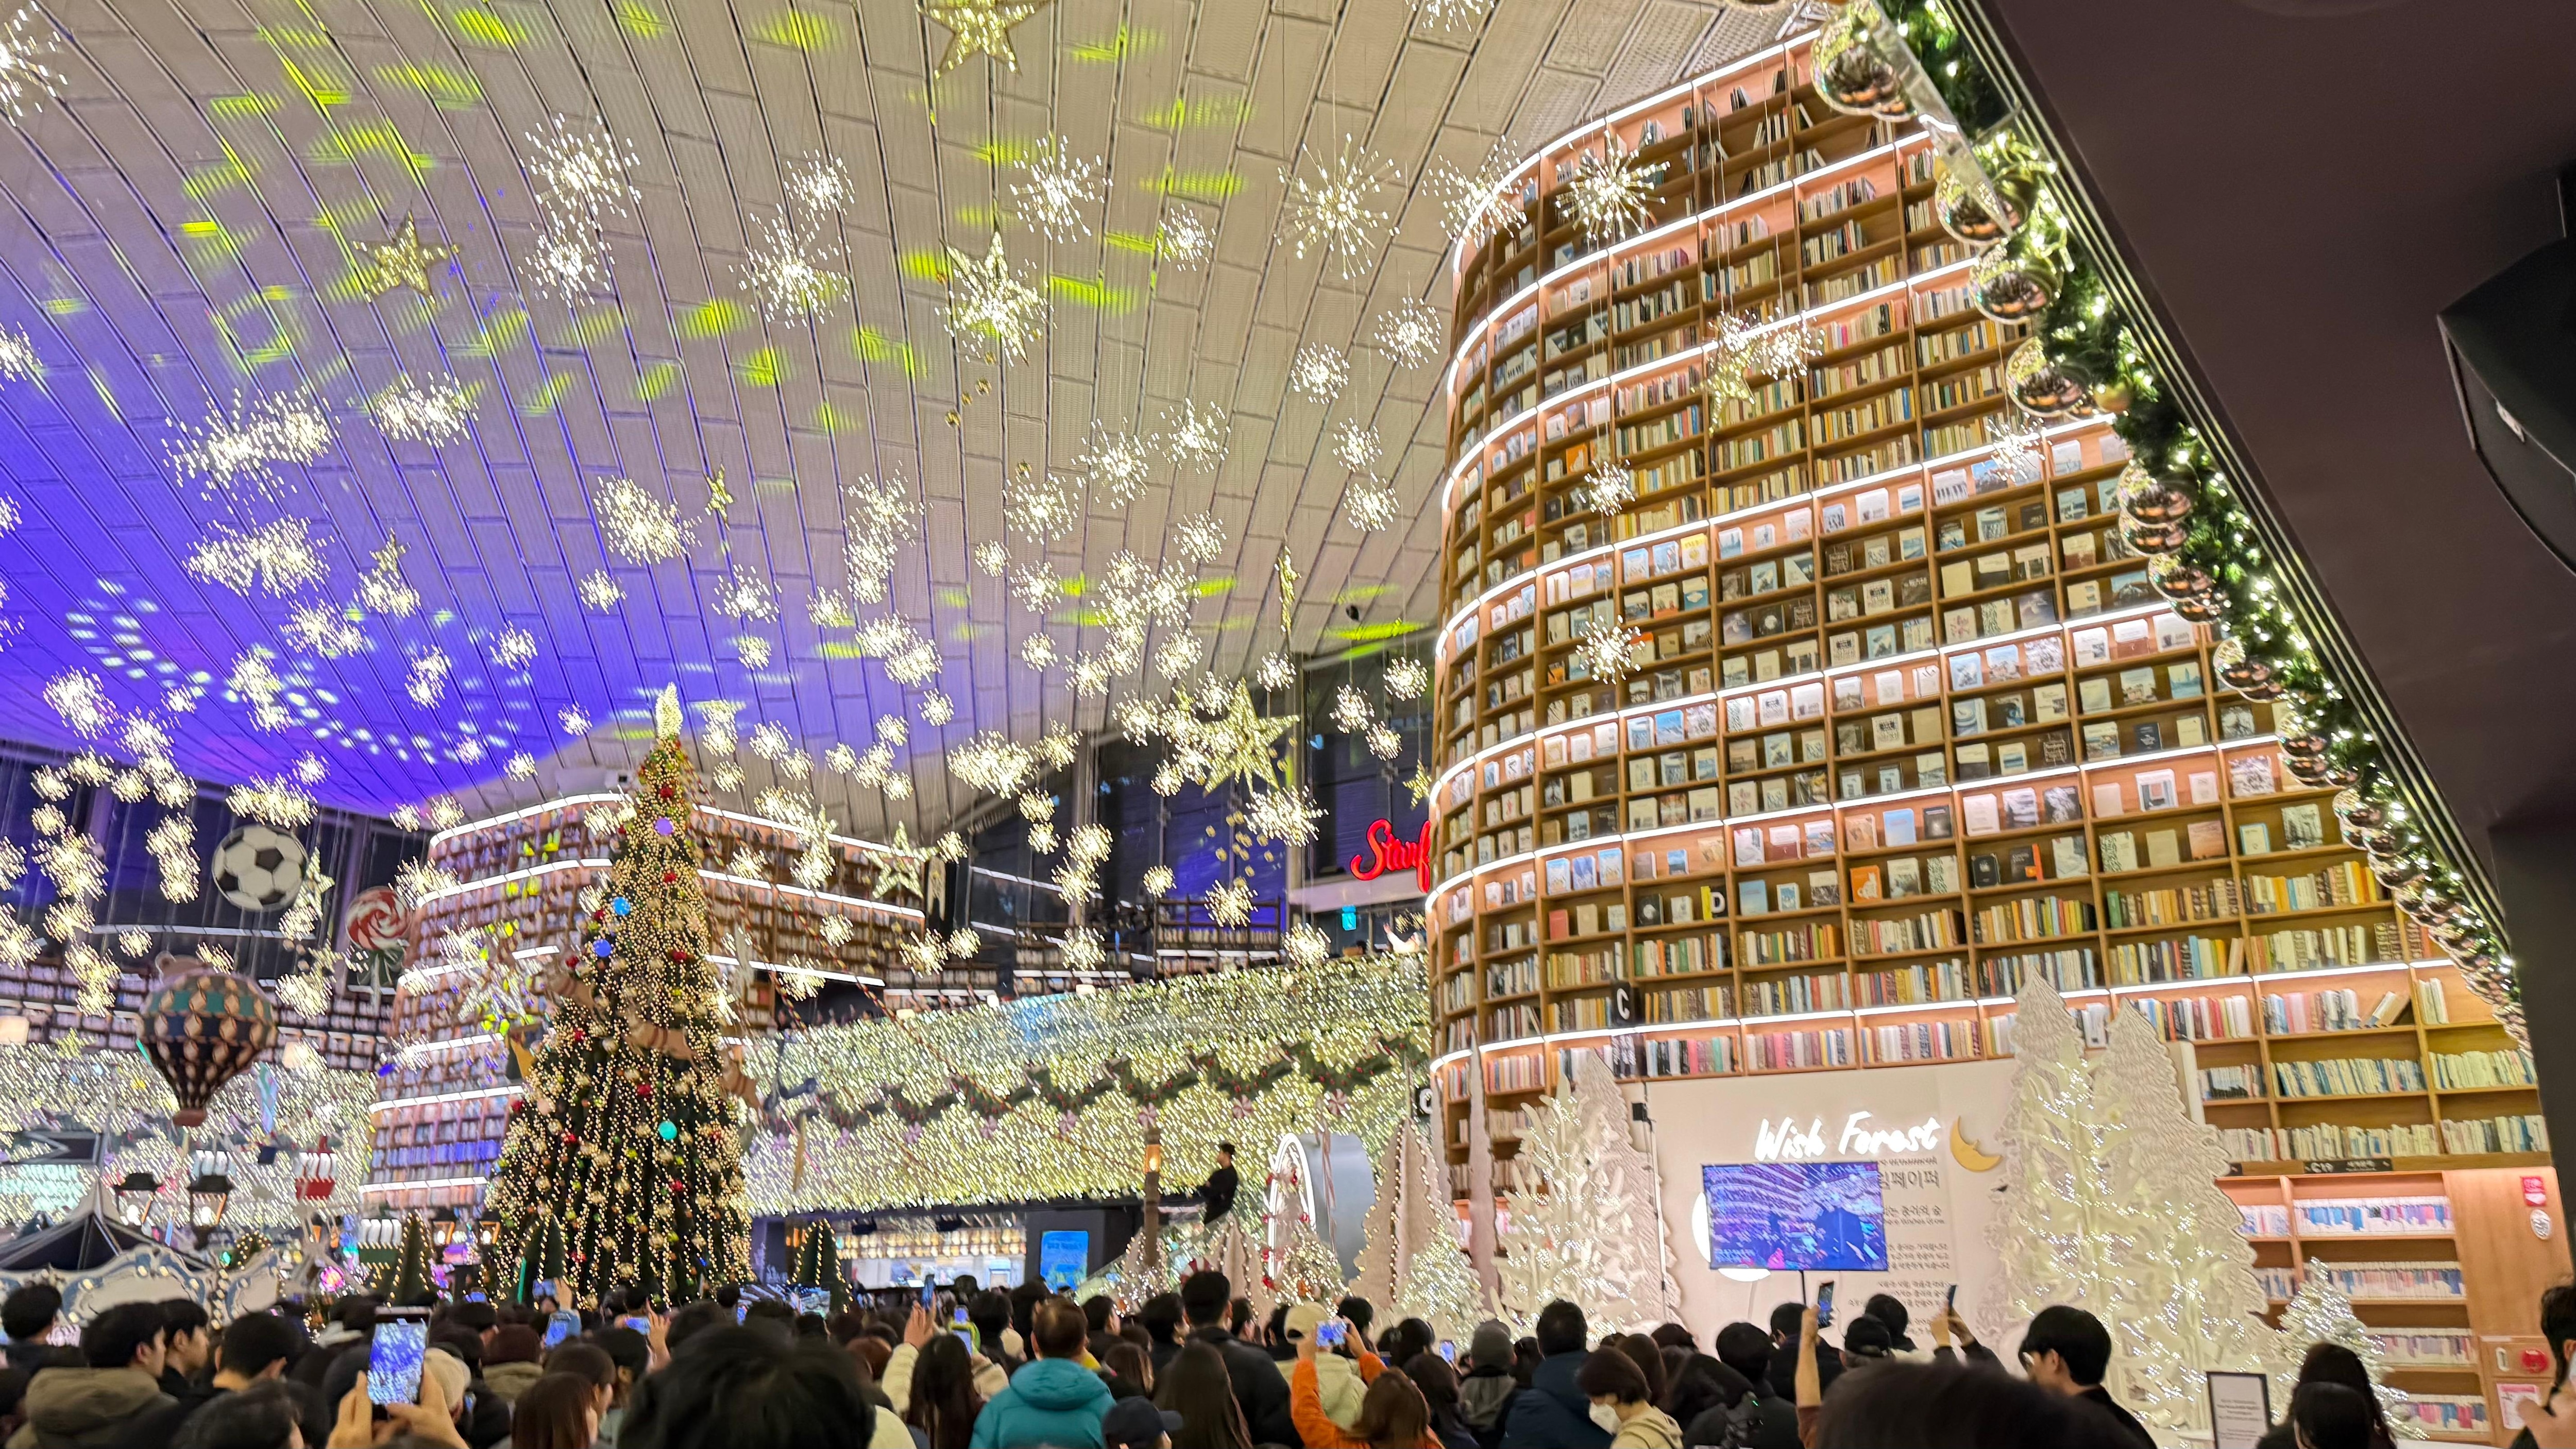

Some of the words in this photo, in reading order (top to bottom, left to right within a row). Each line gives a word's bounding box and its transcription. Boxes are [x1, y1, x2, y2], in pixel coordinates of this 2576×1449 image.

[1617, 987, 1631, 1020] C
[1755, 1116, 1826, 1161] Wish
[1838, 1111, 1941, 1155] Forest
